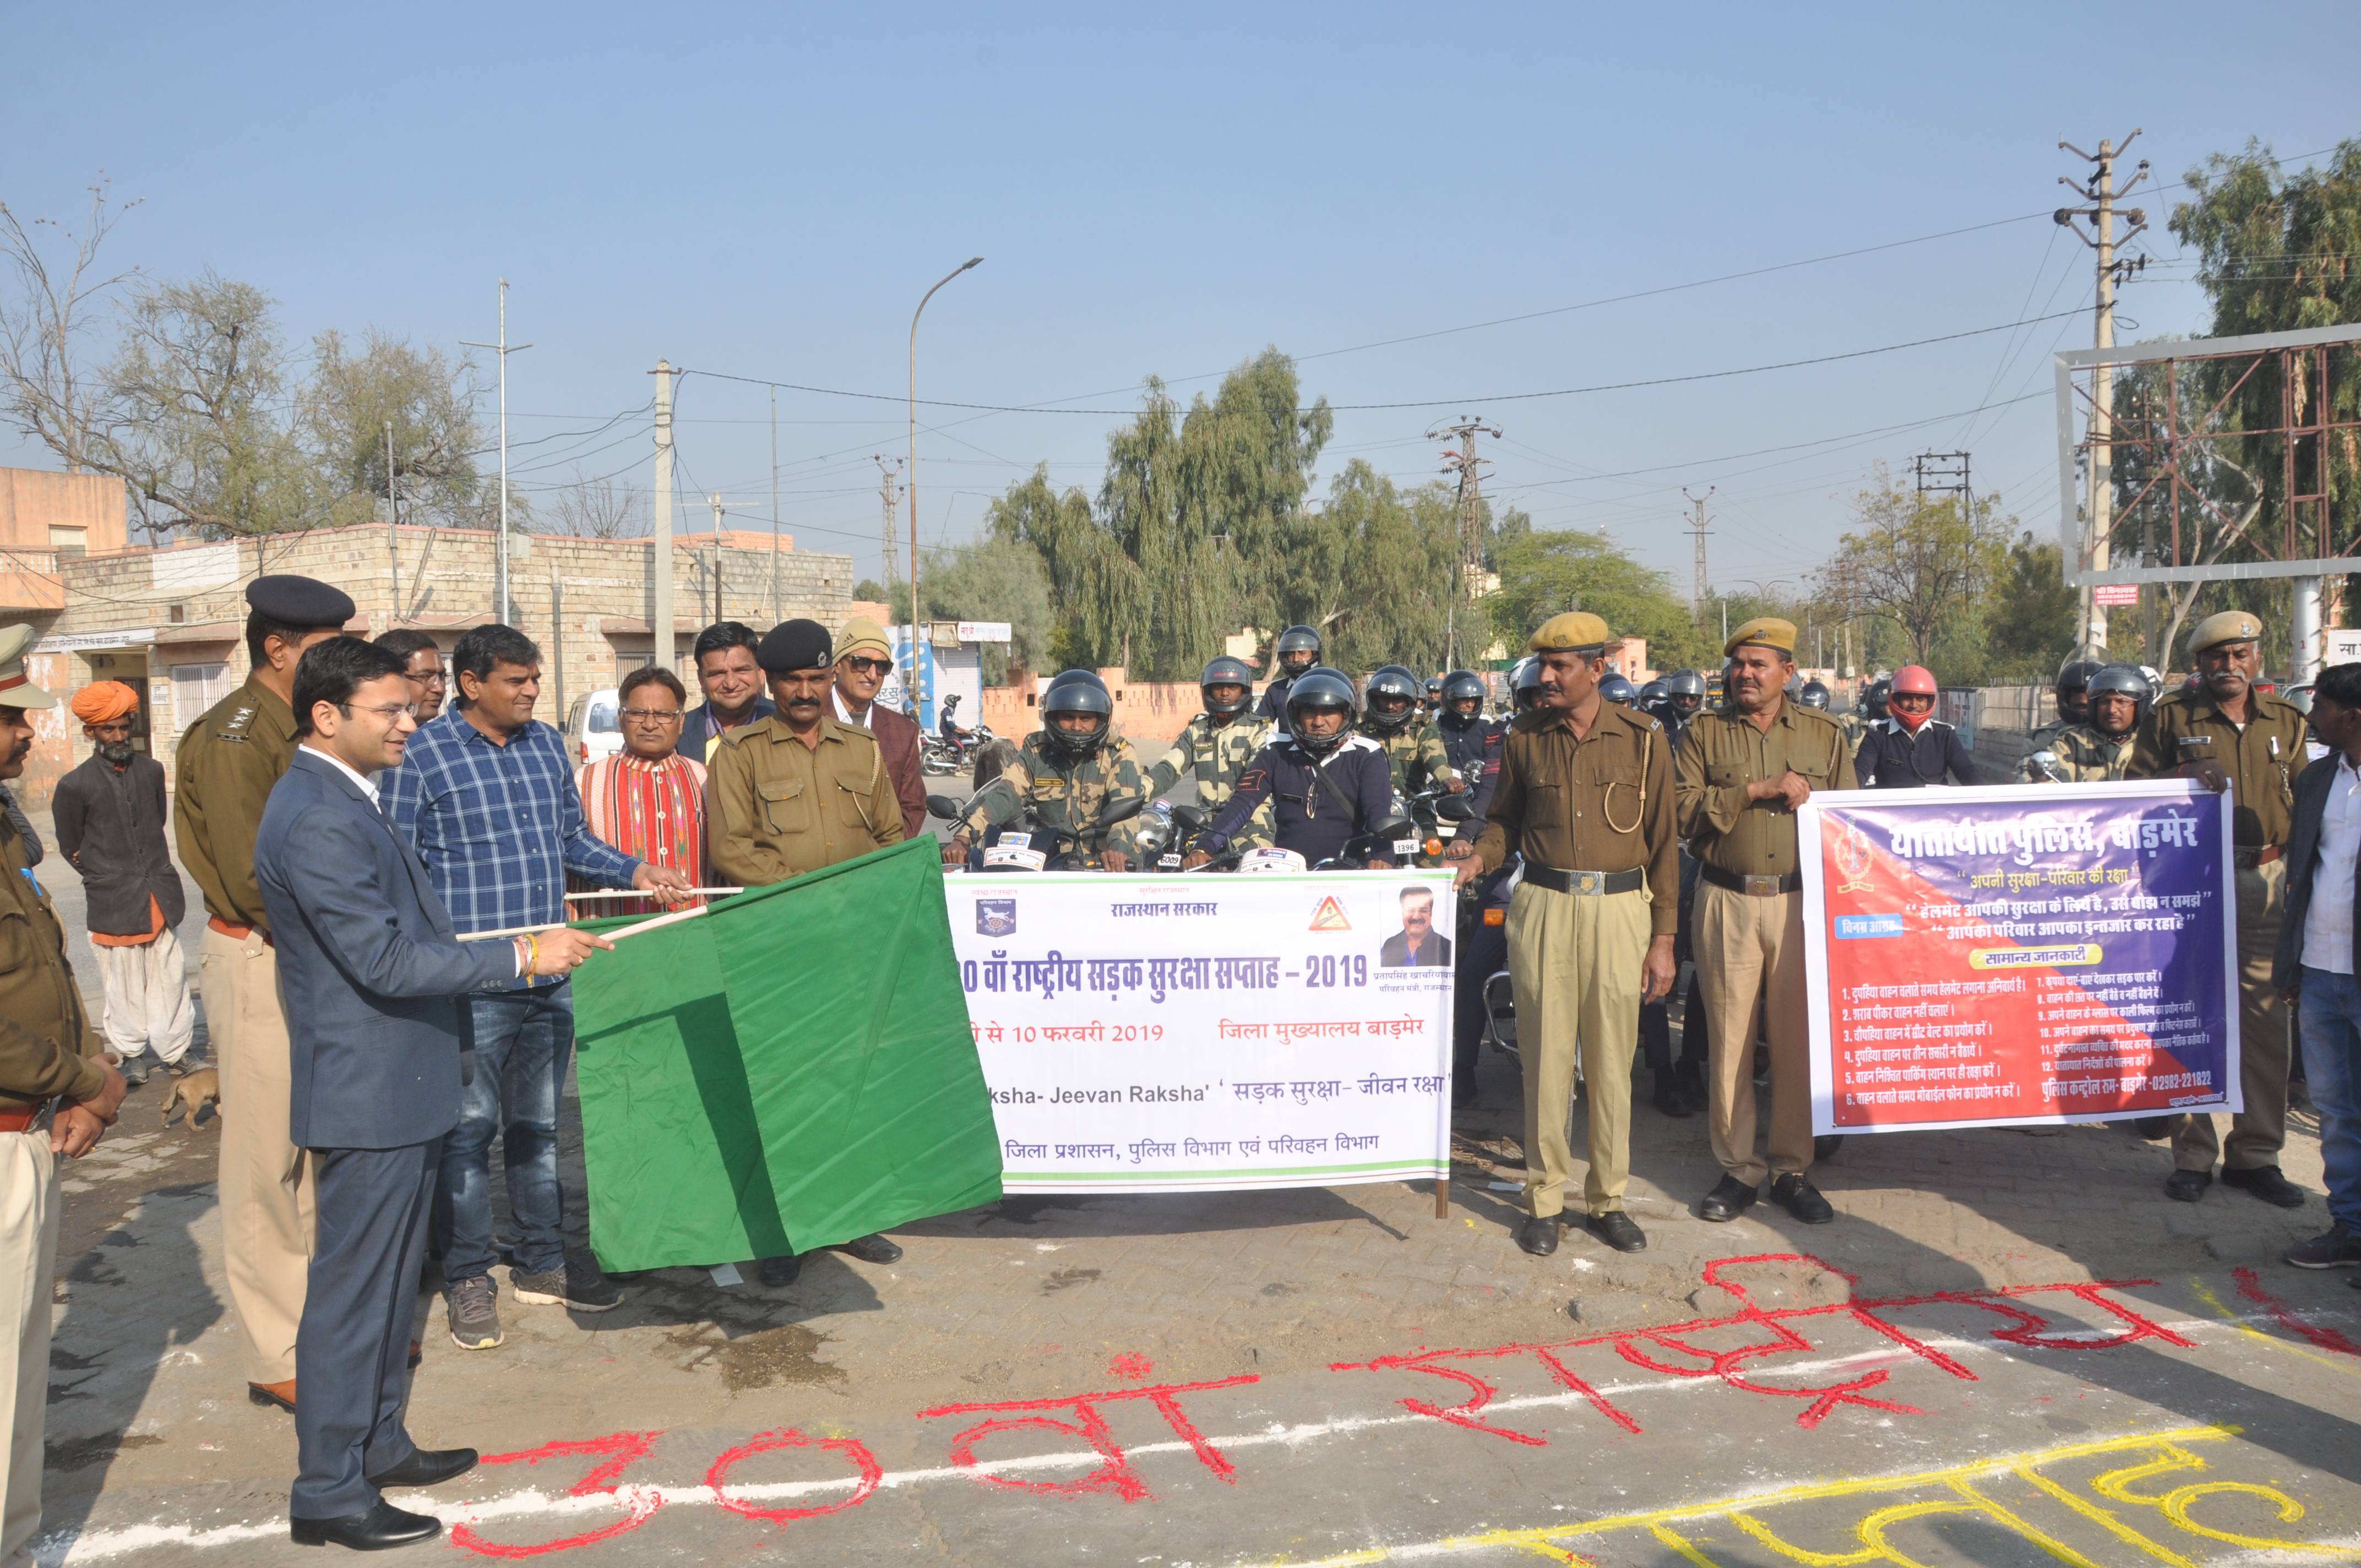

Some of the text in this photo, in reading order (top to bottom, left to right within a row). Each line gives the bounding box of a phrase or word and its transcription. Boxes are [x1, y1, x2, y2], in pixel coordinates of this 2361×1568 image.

[1380, 683, 1402, 694] BSF
[1889, 824, 2008, 858] यातायात
[2108, 808, 2199, 858] बाड़मेर
[2088, 863, 2104, 885] की
[1111, 902, 1218, 917] राजस्थान सरकार
[1964, 898, 2009, 918] आपकी
[2011, 900, 2047, 920] सुरक्षा
[2048, 897, 2062, 914] के
[2063, 895, 2091, 913] लिये
[2109, 893, 2130, 911] उसे
[2131, 892, 2158, 910] बोझ
[2159, 895, 2170, 908] न
[1993, 920, 2036, 938] परिवार
[2038, 921, 2083, 936] आपका
[2085, 918, 2132, 934] इन्तजार
[2134, 917, 2153, 932] कर
[2154, 917, 2174, 931] रहा
[1985, 946, 2086, 966] सामान्य जानकारी
[957, 960, 978, 993] 0
[1011, 950, 1084, 1000] राष्ट्रीय
[1087, 959, 1144, 1001] सड़क
[1147, 957, 1211, 1004] सुरक्षा
[1214, 956, 1281, 990] सप्ताह
[1306, 954, 1367, 988] 2019
[1379, 984, 1405, 993] परिवहन
[1423, 983, 1452, 992] राजस्थान
[2093, 972, 2116, 984] देखकर
[2117, 973, 2134, 986] सड़क
[2134, 972, 2145, 983] पार
[1852, 983, 1878, 1004] दुपहिया
[1879, 986, 1898, 998] वाहन
[1899, 981, 1919, 997] चलाते
[1920, 984, 1938, 997] समय
[1939, 979, 1961, 995] हेलमेट
[1962, 982, 1985, 994] लगाना
[1987, 977, 2015, 994] अनिवार्य
[1852, 1008, 1872, 1021] शराब
[1873, 1004, 1892, 1019] पीकर
[1894, 1006, 1912, 1019] वाहन
[1913, 1002, 1928, 1017] नहीं
[984, 1020, 1005, 1044] से
[1012, 1025, 1036, 1042] 10
[1041, 1020, 1106, 1043] फरवरी
[1111, 1024, 1164, 1042] 2019
[1217, 1017, 1270, 1040] जिला
[1273, 1021, 1361, 1046] मुख्यालय
[1365, 1013, 1425, 1043] बाड़मेर
[1853, 1025, 1883, 1041] चौपहिया
[1884, 1028, 1903, 1040] वाहन
[1927, 1022, 1941, 1038] बेल्ट
[1943, 1025, 1954, 1037] का
[1954, 1021, 1974, 1038] प्रयोग
[1854, 1047, 1881, 1067] दुपहिया
[1882, 1049, 1901, 1061] वाहन
[1902, 1048, 1912, 1061] पर
[1912, 1044, 1927, 1060] तीन
[1950, 1046, 1957, 1058] न
[1855, 1071, 1874, 1084] वाहन
[1875, 1066, 1902, 1083] निश्चित
[1927, 1068, 1946, 1080] स्थान
[1946, 1067, 1957, 1079] पर
[1957, 1063, 1965, 1079] ही
[1966, 1066, 1982, 1081] खड़ा
[988, 1086, 1044, 1104] ksha-
[1049, 1086, 1122, 1104] Jeevan
[1232, 1082, 1286, 1105] सड़क
[1356, 1072, 1408, 1095] जीवन
[1856, 1092, 1875, 1105] वाहन
[1876, 1087, 1897, 1104] चलाते
[1897, 1091, 1916, 1103] समय
[1916, 1086, 1946, 1103] मोबाईल
[1946, 1085, 1962, 1101] फोन
[1963, 1087, 1974, 1099] का
[1974, 1083, 1993, 1099] प्रयोग
[1994, 1086, 2001, 1098] न
[2041, 1077, 2068, 1103] पुलिस
[2120, 1072, 2147, 1095] बाड़मेर
[1005, 1132, 1380, 1164] जिला प्रशासन, पुलिस विभाग एवं परिवहन विभाग
